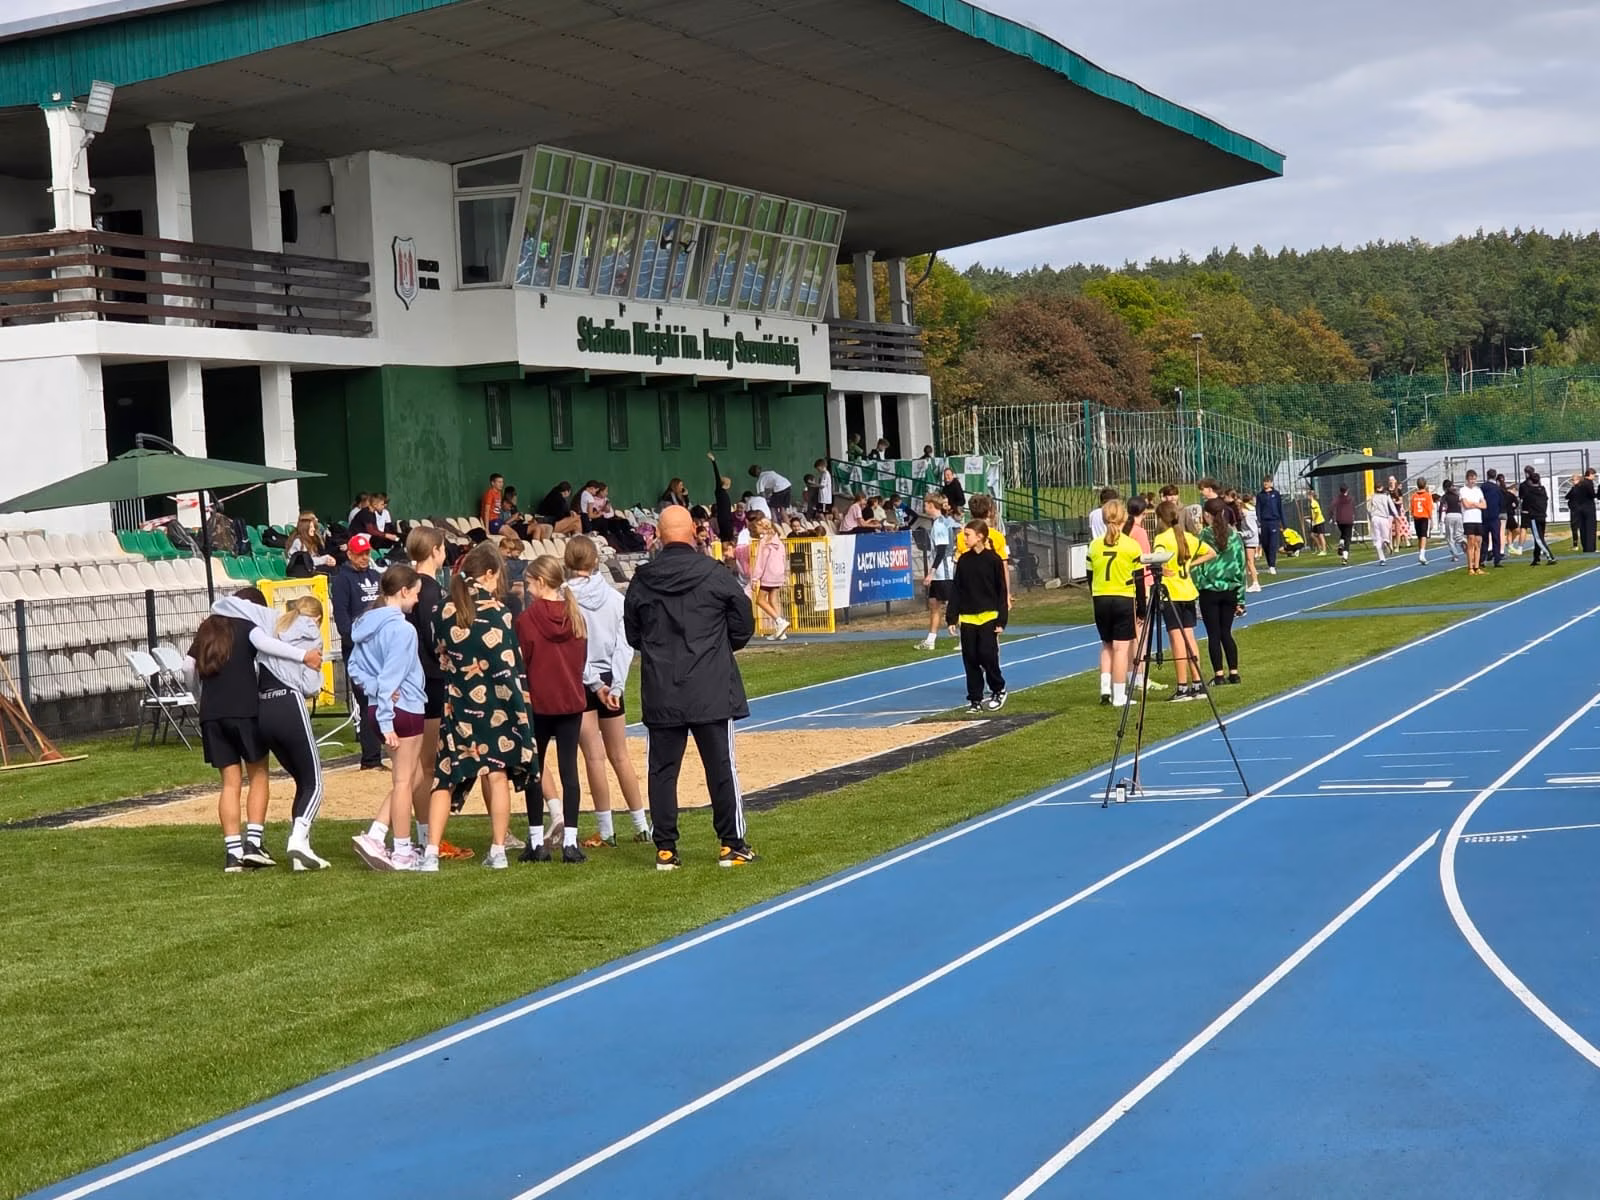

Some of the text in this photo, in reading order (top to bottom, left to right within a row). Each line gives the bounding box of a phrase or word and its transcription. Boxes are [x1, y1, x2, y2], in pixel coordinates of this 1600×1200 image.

[577, 316, 632, 355] Stadion
[632, 322, 681, 366] Miejski
[876, 551, 890, 569] NAS
[889, 549, 909, 568] SPORT!
[1103, 551, 1118, 582] 7
